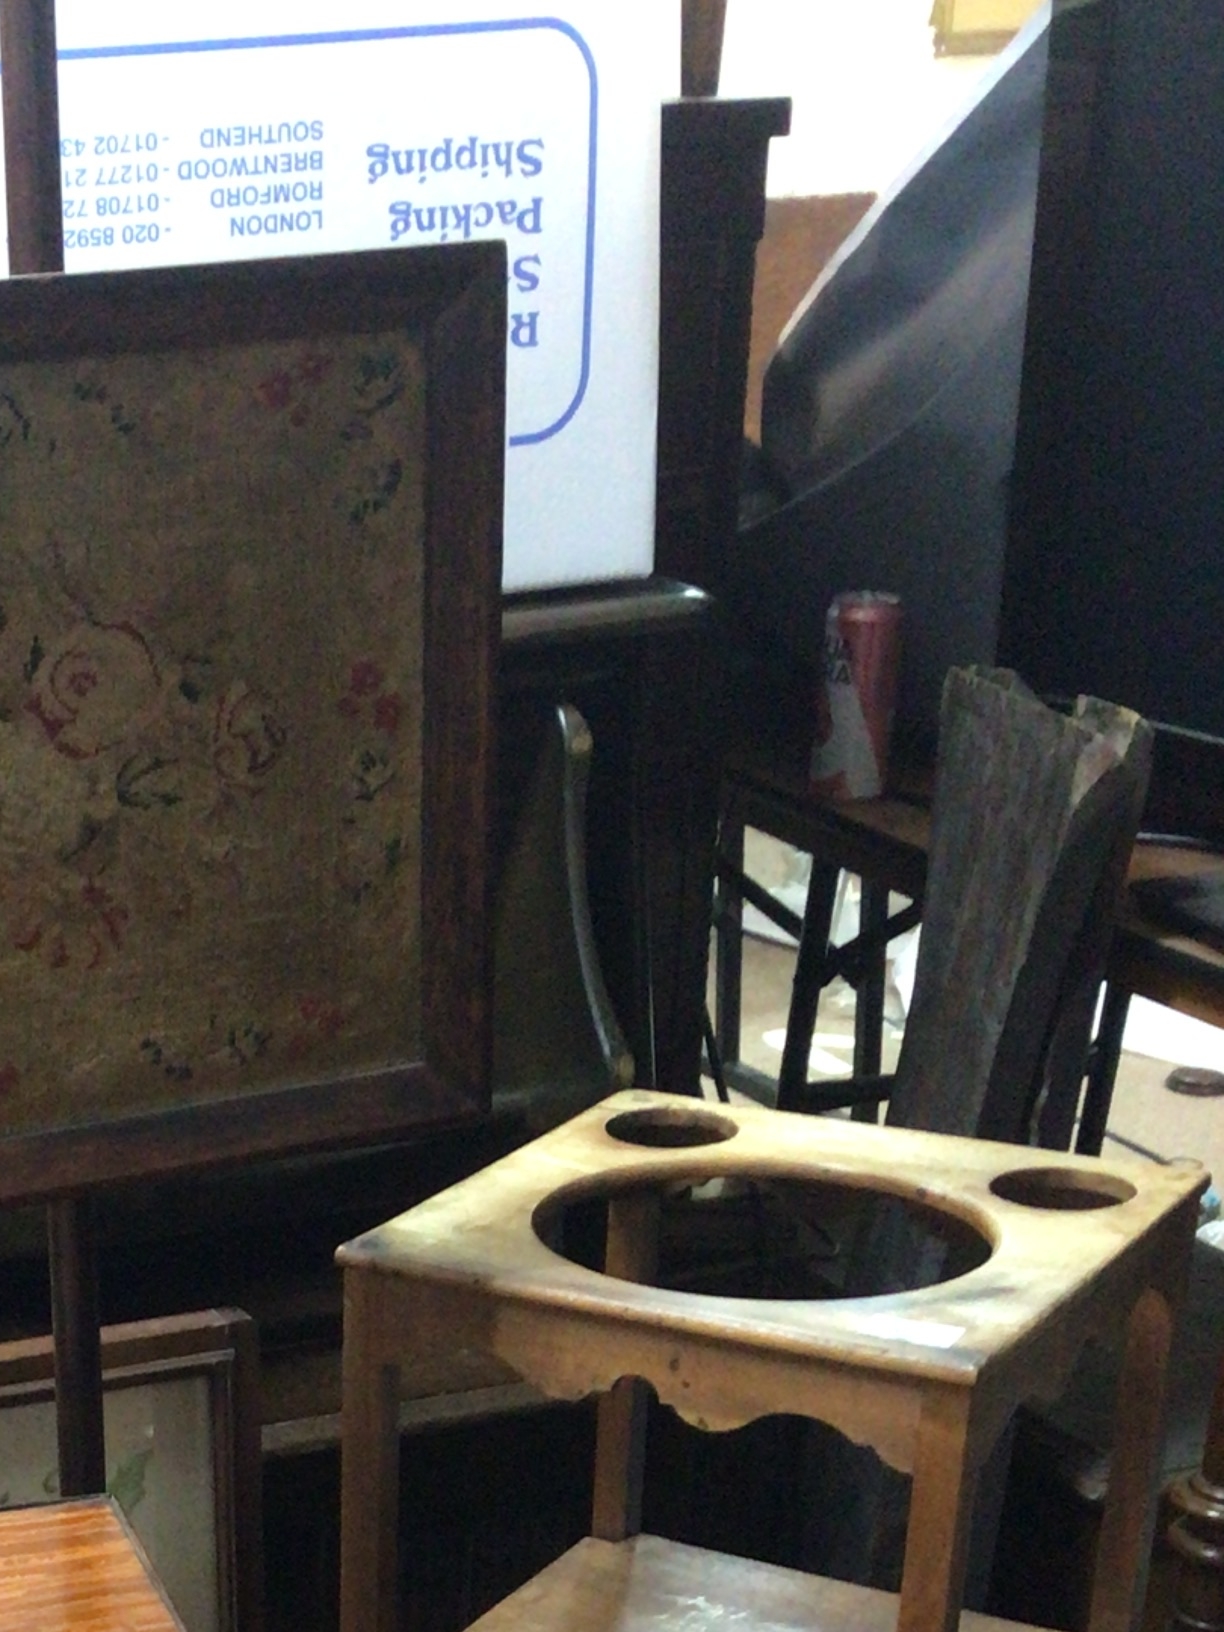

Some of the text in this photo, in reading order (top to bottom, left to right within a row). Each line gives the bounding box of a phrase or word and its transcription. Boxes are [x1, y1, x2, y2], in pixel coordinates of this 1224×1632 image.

[93, 132, 158, 155] 01702
[200, 119, 324, 149] SOUTHEND
[94, 163, 159, 186] 01277
[177, 150, 324, 180] BRENTWOOD
[366, 136, 545, 185] Shipping
[96, 192, 160, 216] 01708
[210, 180, 324, 208] ROMFORD
[121, 222, 160, 244] 020
[230, 209, 324, 238] LONDON
[388, 196, 544, 242] Packing
[63, 226, 114, 249] 8592
[509, 253, 542, 293] S
